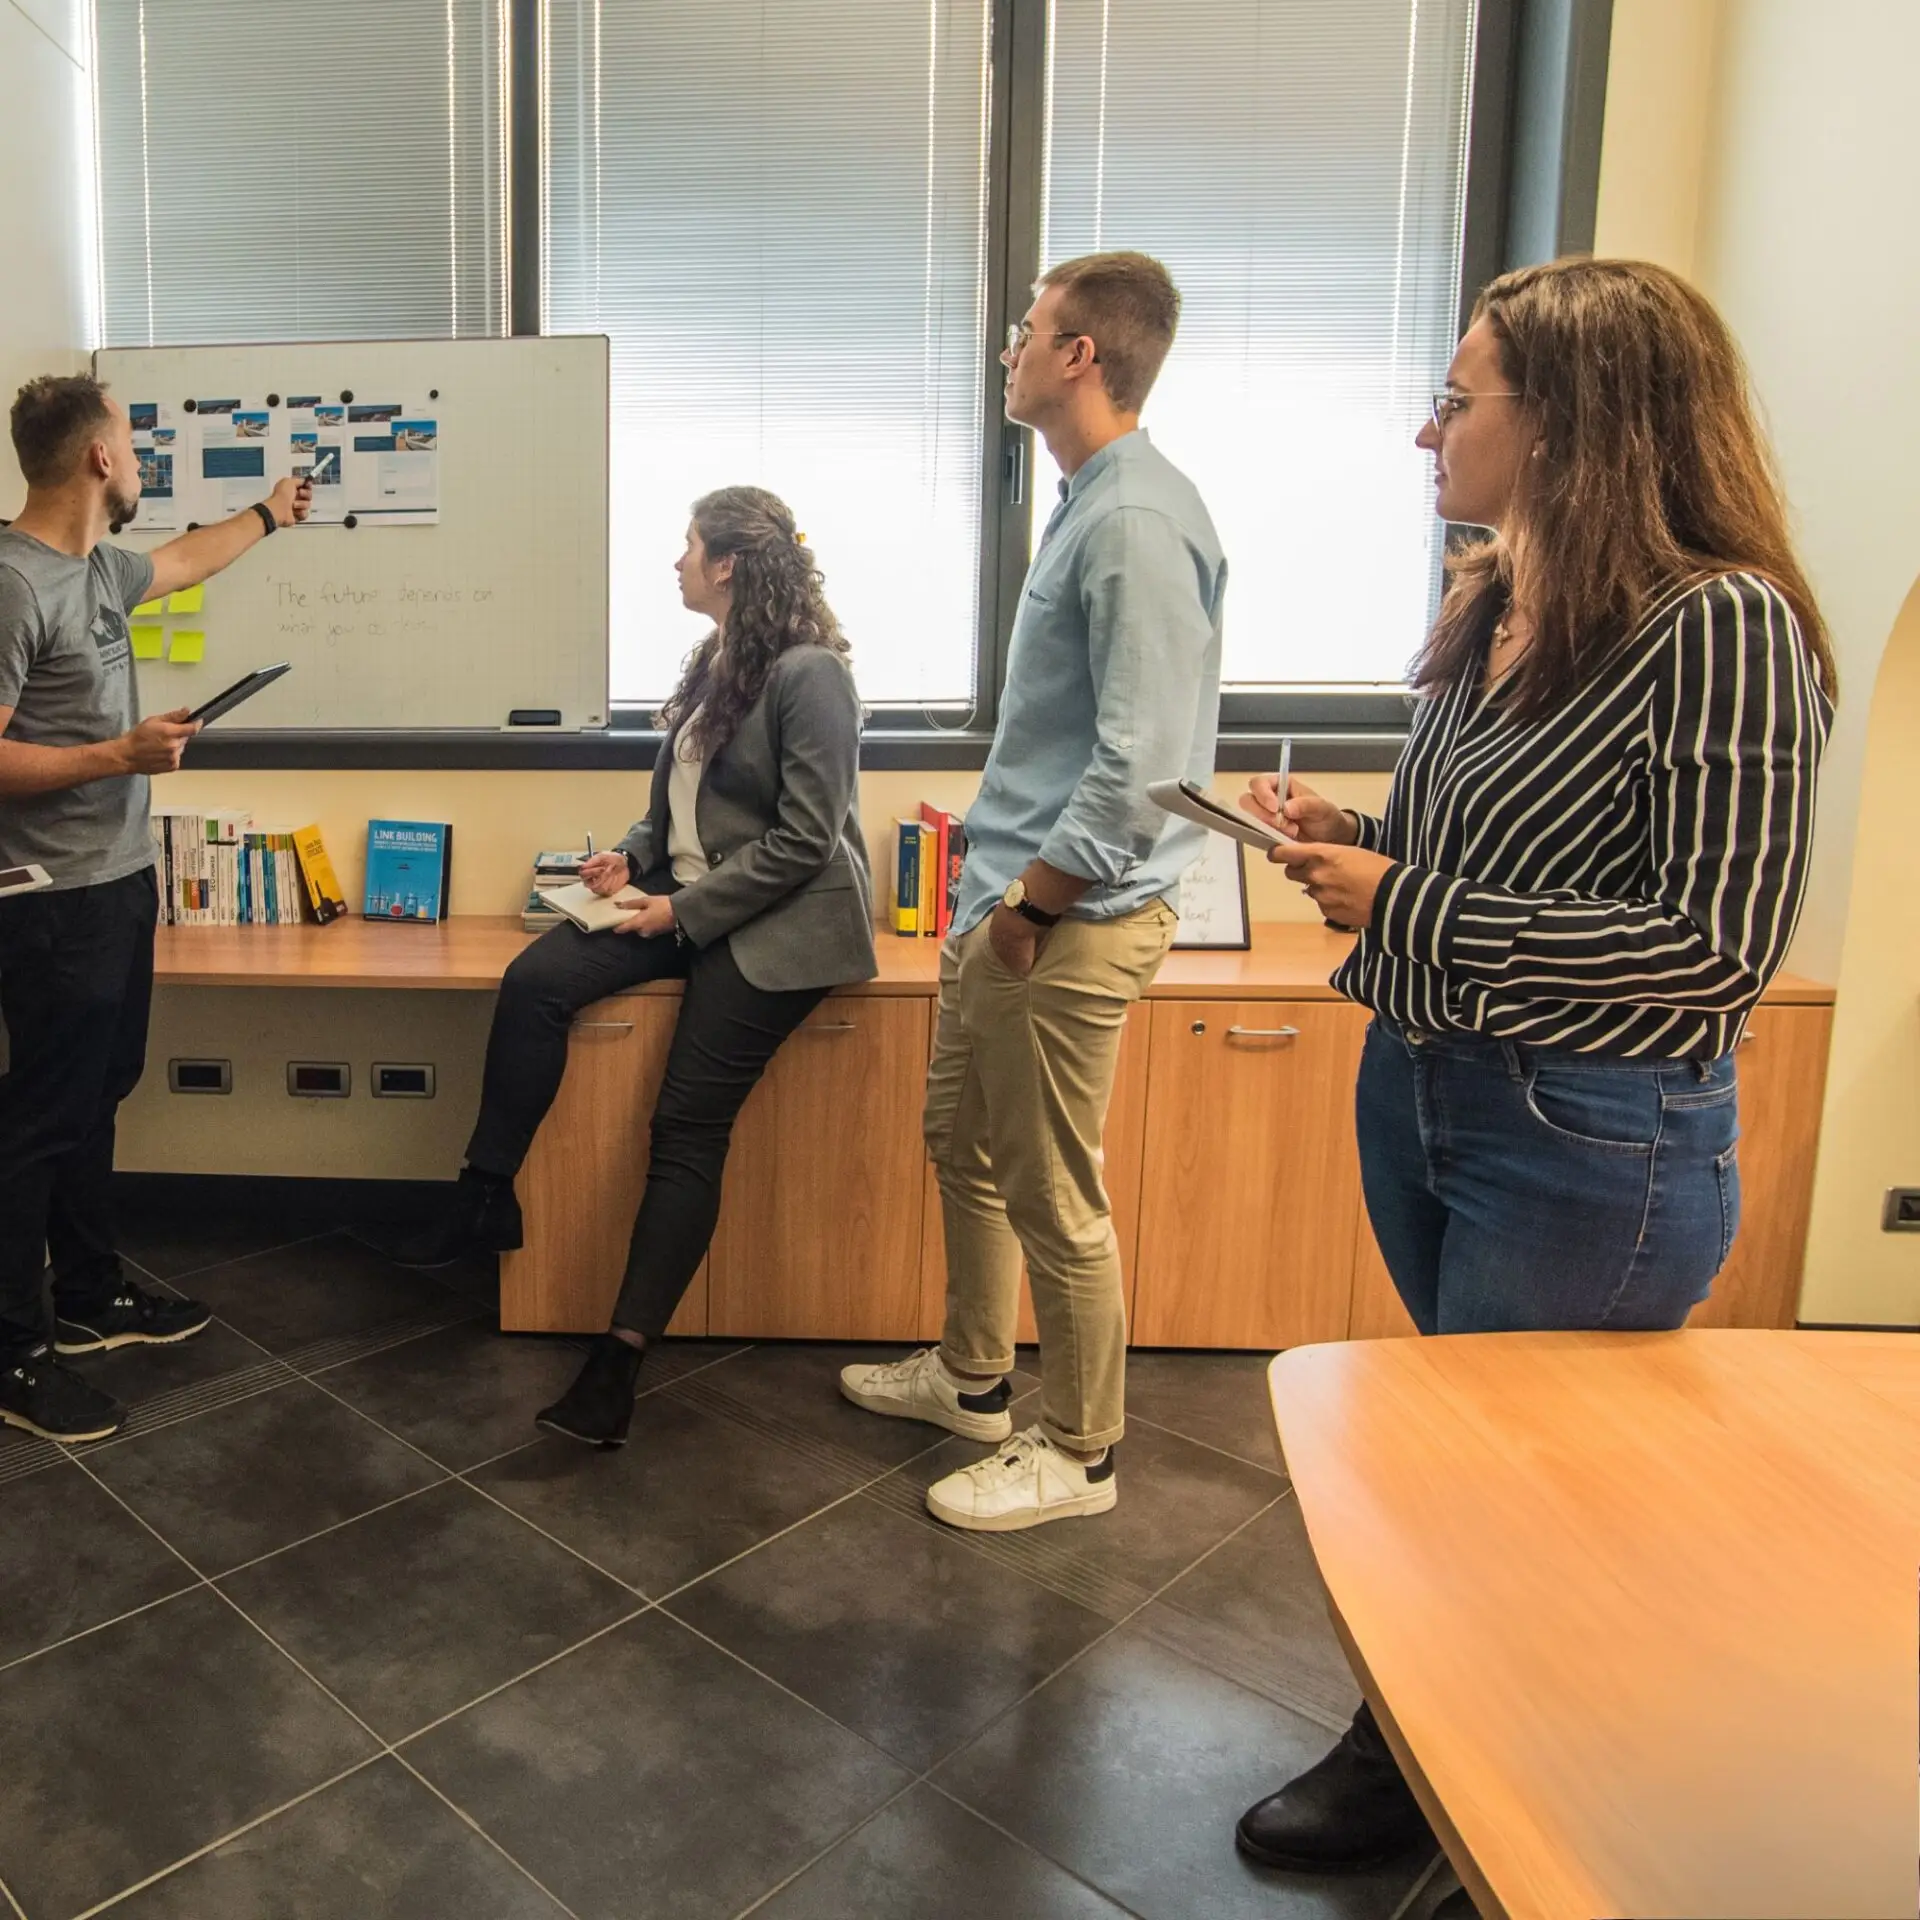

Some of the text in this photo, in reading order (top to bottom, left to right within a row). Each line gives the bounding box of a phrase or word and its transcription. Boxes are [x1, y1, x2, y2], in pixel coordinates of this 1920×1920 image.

[326, 621, 355, 647] you
[374, 829, 438, 843] LINK BUILDING
